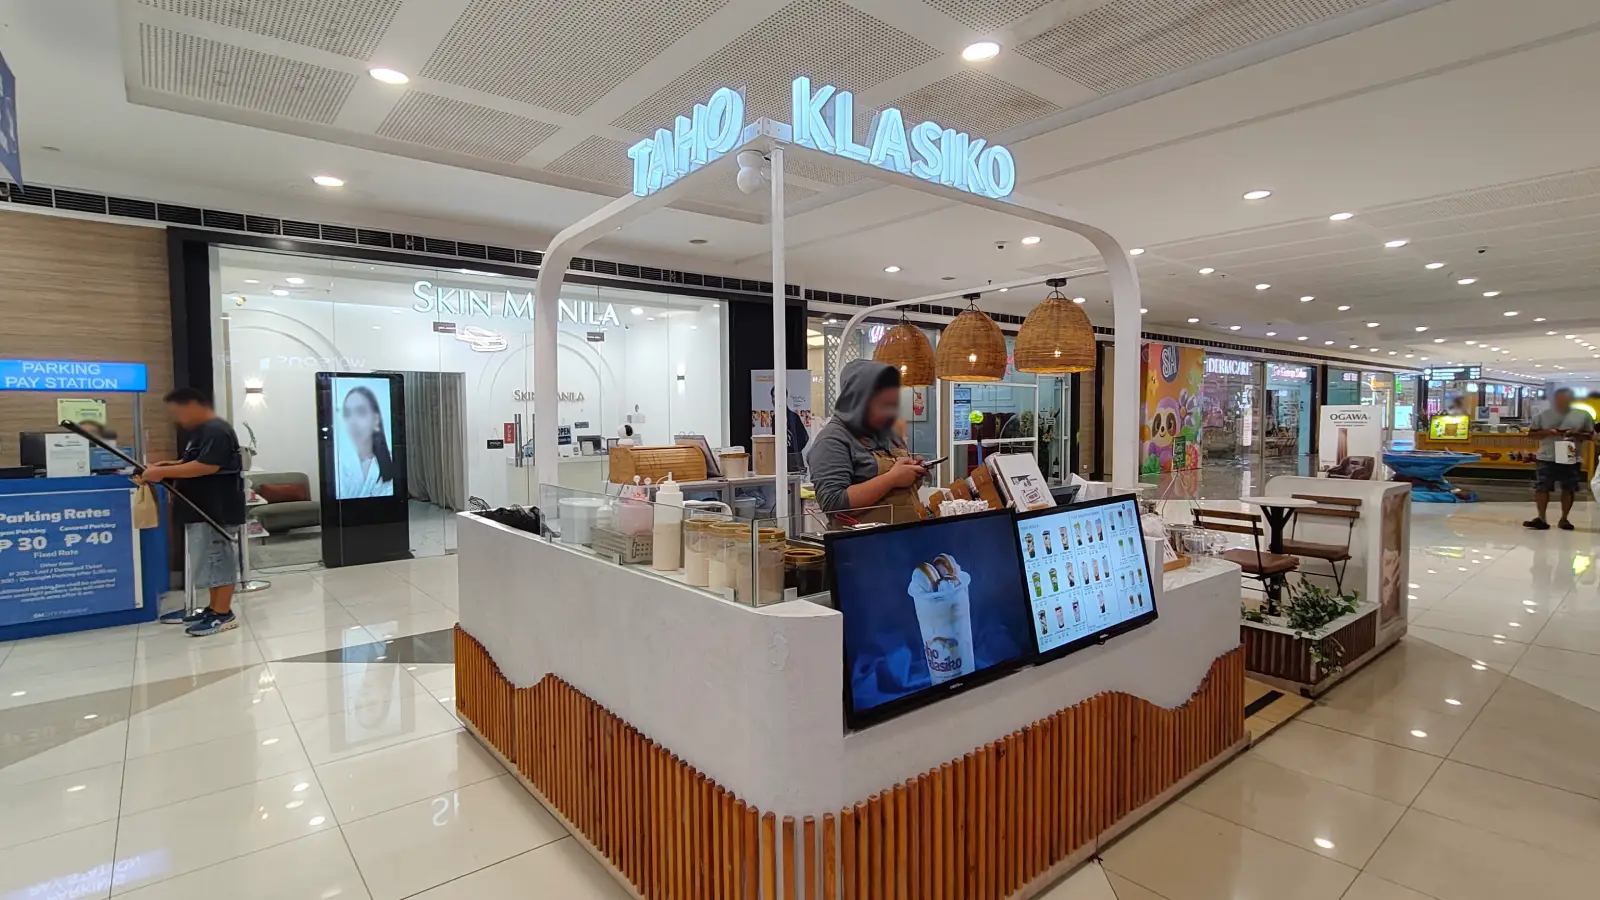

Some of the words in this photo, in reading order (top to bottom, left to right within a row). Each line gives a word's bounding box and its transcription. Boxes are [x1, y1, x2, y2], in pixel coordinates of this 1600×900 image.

[627, 86, 745, 197] TAHO
[792, 76, 1016, 200] KLASIKO
[412, 281, 492, 318] SKIN
[502, 289, 620, 326] MNILA
[22, 362, 101, 375] PARKING
[5, 377, 39, 388] PAY
[44, 377, 118, 389] STATION
[1329, 413, 1368, 421] OGAWA
[64, 508, 111, 520] Rates
[15, 527, 46, 535] Parking
[59, 524, 88, 532] Covered
[89, 522, 116, 530] Parking
[18, 535, 48, 551] 30
[85, 531, 113, 545] 40
[33, 550, 57, 559] Fixed
[58, 549, 79, 557] Rate
